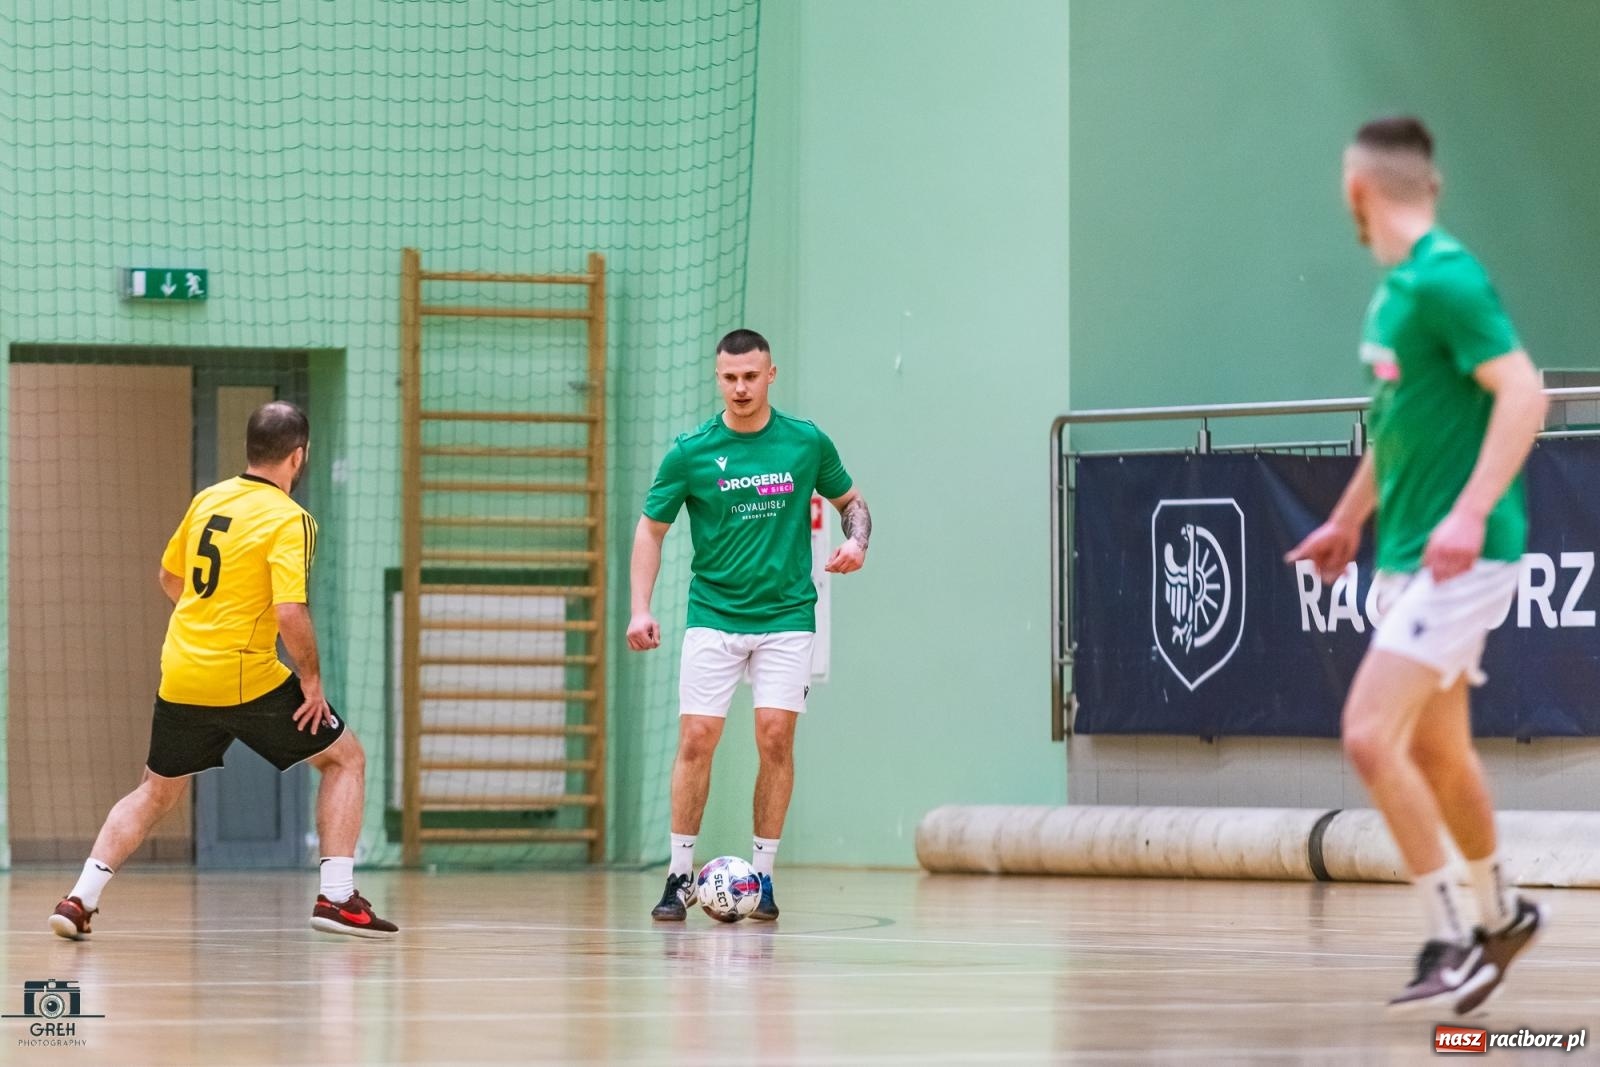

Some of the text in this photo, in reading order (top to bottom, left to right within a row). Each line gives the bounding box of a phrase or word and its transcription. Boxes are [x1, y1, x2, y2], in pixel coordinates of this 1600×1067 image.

[719, 471, 793, 492] DROGERIA
[771, 484, 792, 493] SIECI
[192, 514, 233, 599] 5
[714, 873, 729, 908] SELECT
